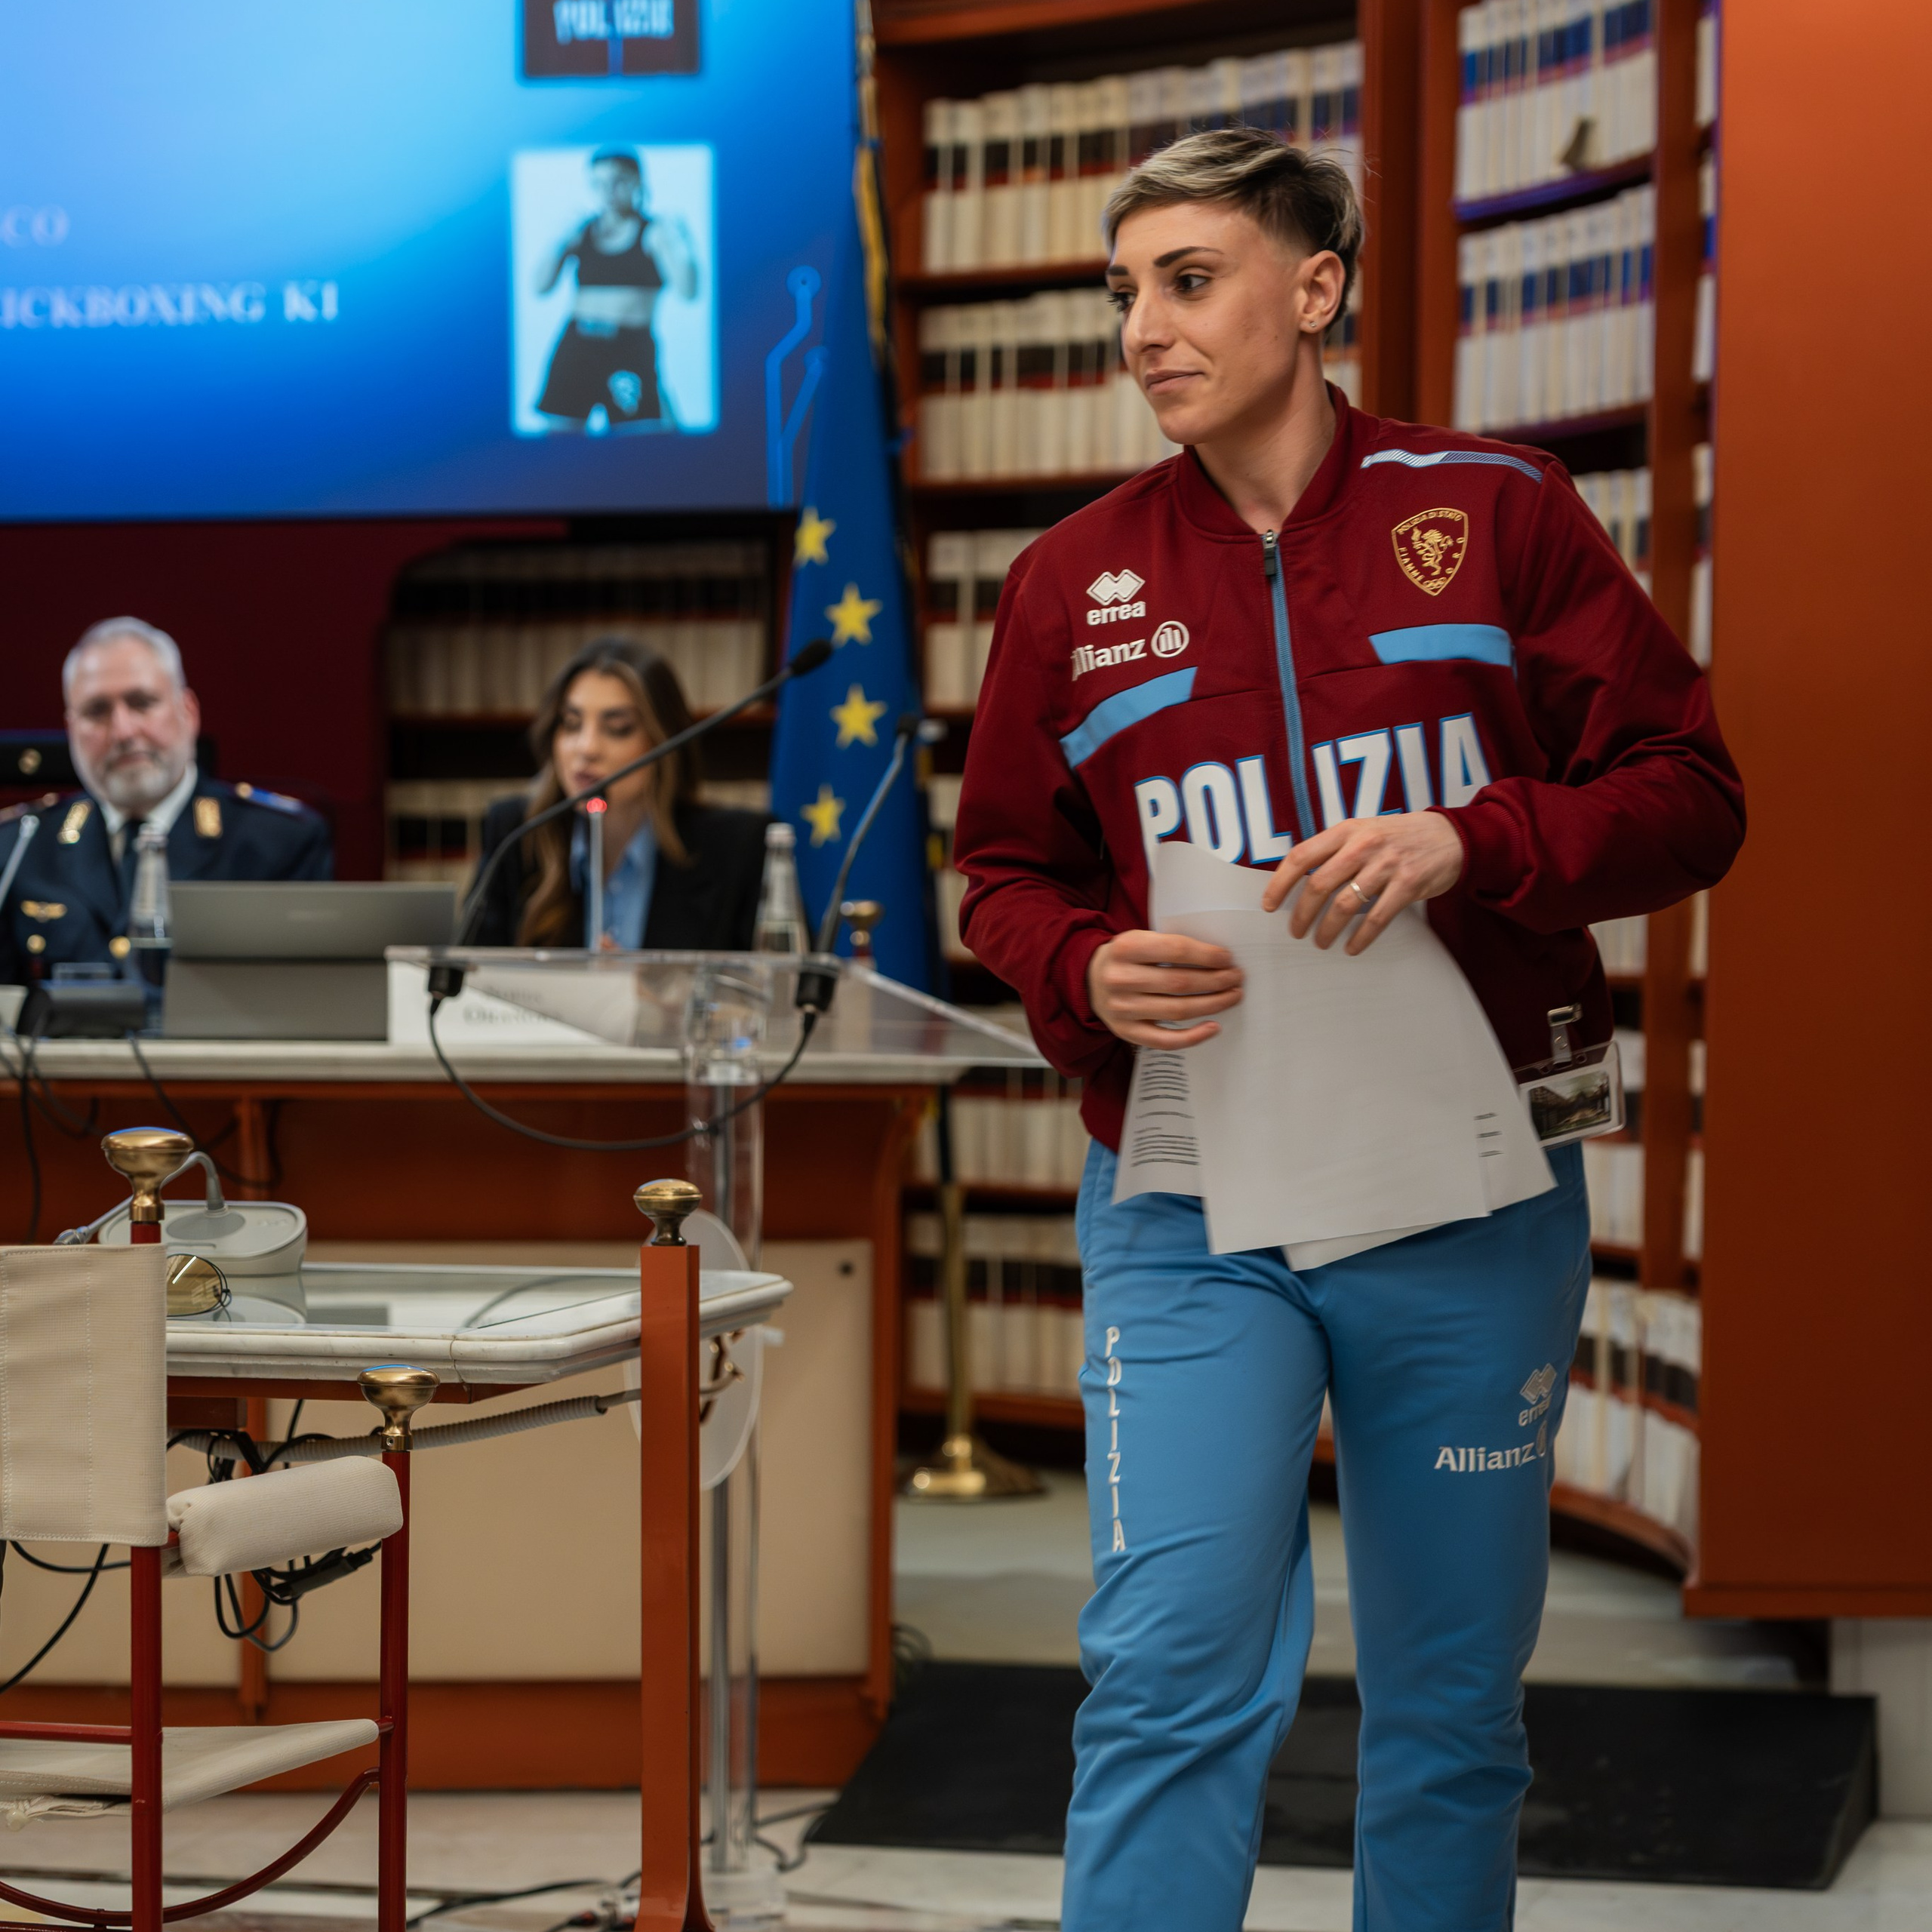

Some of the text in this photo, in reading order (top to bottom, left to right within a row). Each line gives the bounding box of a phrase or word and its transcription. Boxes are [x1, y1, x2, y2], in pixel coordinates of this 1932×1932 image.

[1086, 601, 1146, 626] errea
[1070, 638, 1147, 681] llianz
[1134, 712, 1494, 879] POLIZIA
[1104, 1326, 1126, 1552] POLIZIA
[1434, 1442, 1537, 1472] Allianz
